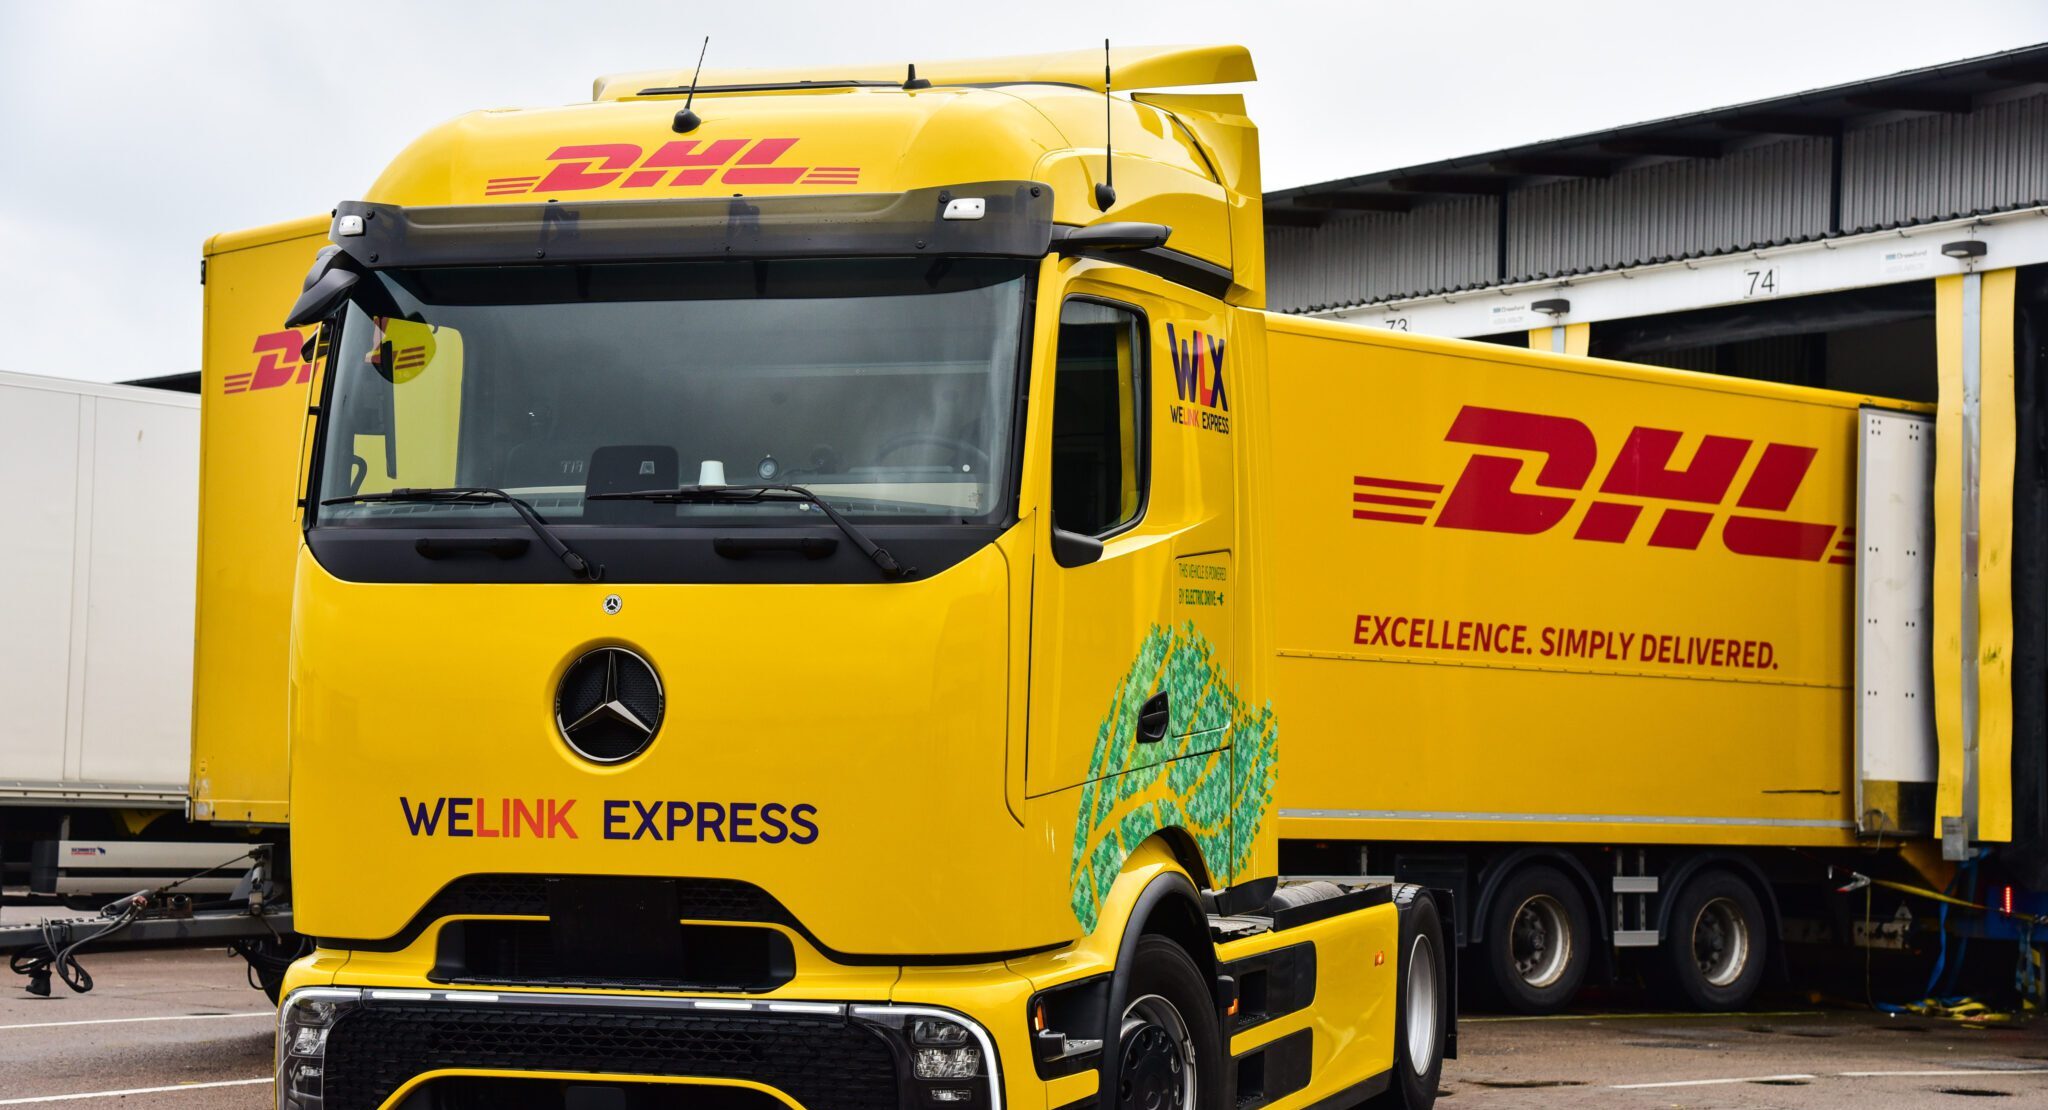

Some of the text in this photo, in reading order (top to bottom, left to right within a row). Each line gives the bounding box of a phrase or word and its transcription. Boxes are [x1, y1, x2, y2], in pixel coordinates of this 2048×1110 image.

[531, 137, 810, 193] DHL
[1747, 269, 1775, 295] 74
[1166, 322, 1229, 412] WLX
[1170, 405, 1229, 435] WELINK EXPRESS
[1434, 405, 1837, 563] DHL
[1354, 614, 1779, 671] EXCELLENCE. SIMPLY DELIVERED.
[400, 797, 820, 845] WELINK EXPRESS
